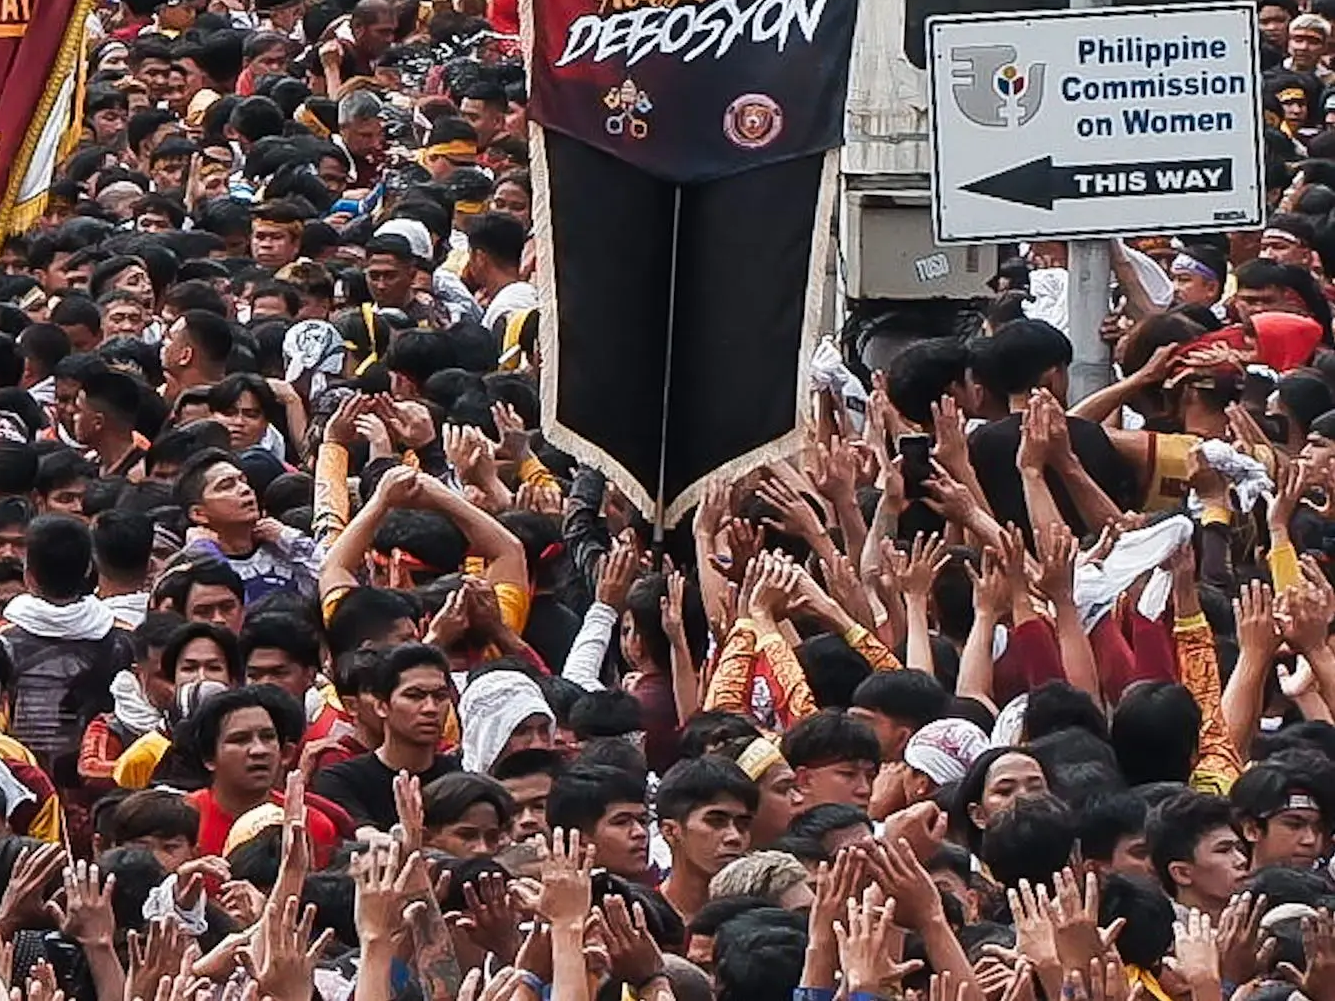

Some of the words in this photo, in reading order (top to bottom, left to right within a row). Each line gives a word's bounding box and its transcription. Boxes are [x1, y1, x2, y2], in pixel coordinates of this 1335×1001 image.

[1078, 34, 1227, 68] Philippine
[1062, 73, 1245, 101] Commission
[1077, 116, 1112, 137] on
[1123, 109, 1233, 135] Women
[1074, 169, 1147, 194] THIS
[1156, 167, 1224, 190] WAY
